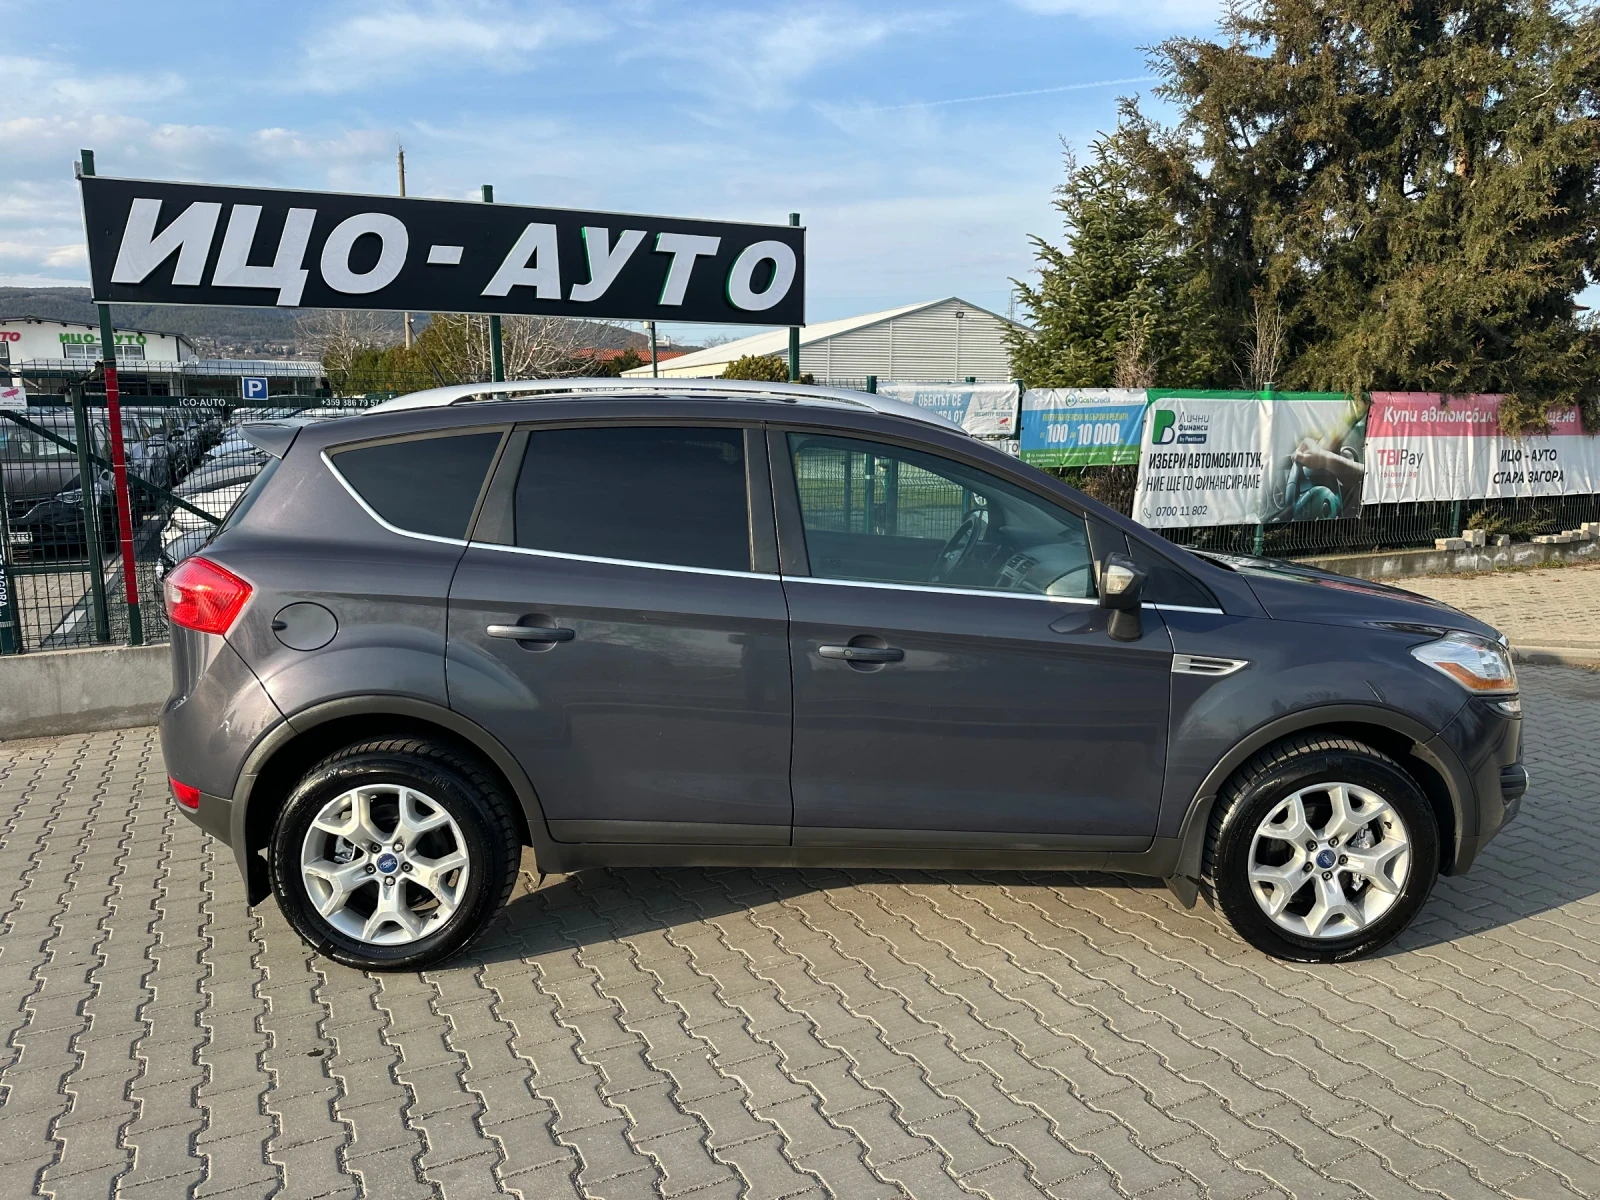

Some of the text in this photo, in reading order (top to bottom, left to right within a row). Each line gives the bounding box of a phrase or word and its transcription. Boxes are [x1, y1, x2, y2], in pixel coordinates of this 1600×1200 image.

[111, 198, 410, 307] ИЦО
[481, 222, 797, 311] АУТО
[59, 333, 147, 346] ИЦО-УТО
[248, 380, 262, 397] P
[918, 393, 962, 407] ОБЕКТЪТ СЕ
[977, 395, 1013, 410] VIA
[953, 410, 964, 423] ОТ
[1178, 411, 1210, 423] Лични
[1383, 405, 1417, 426] Купи
[1047, 423, 1069, 443] 100
[1149, 451, 1264, 470] ИЗБЕРИ АВТОМОБИЛ ТУК,
[1377, 449, 1424, 468] TBIPay
[1500, 449, 1522, 464] ИЦО
[1531, 449, 1557, 462] АУТО
[1146, 474, 1260, 494] НИЕ ЩЕ ГО ФИНАНСИРАМЕ
[1493, 470, 1564, 484] СТАРА ЗАГОРА
[1155, 505, 1208, 517] 0700 11 802
